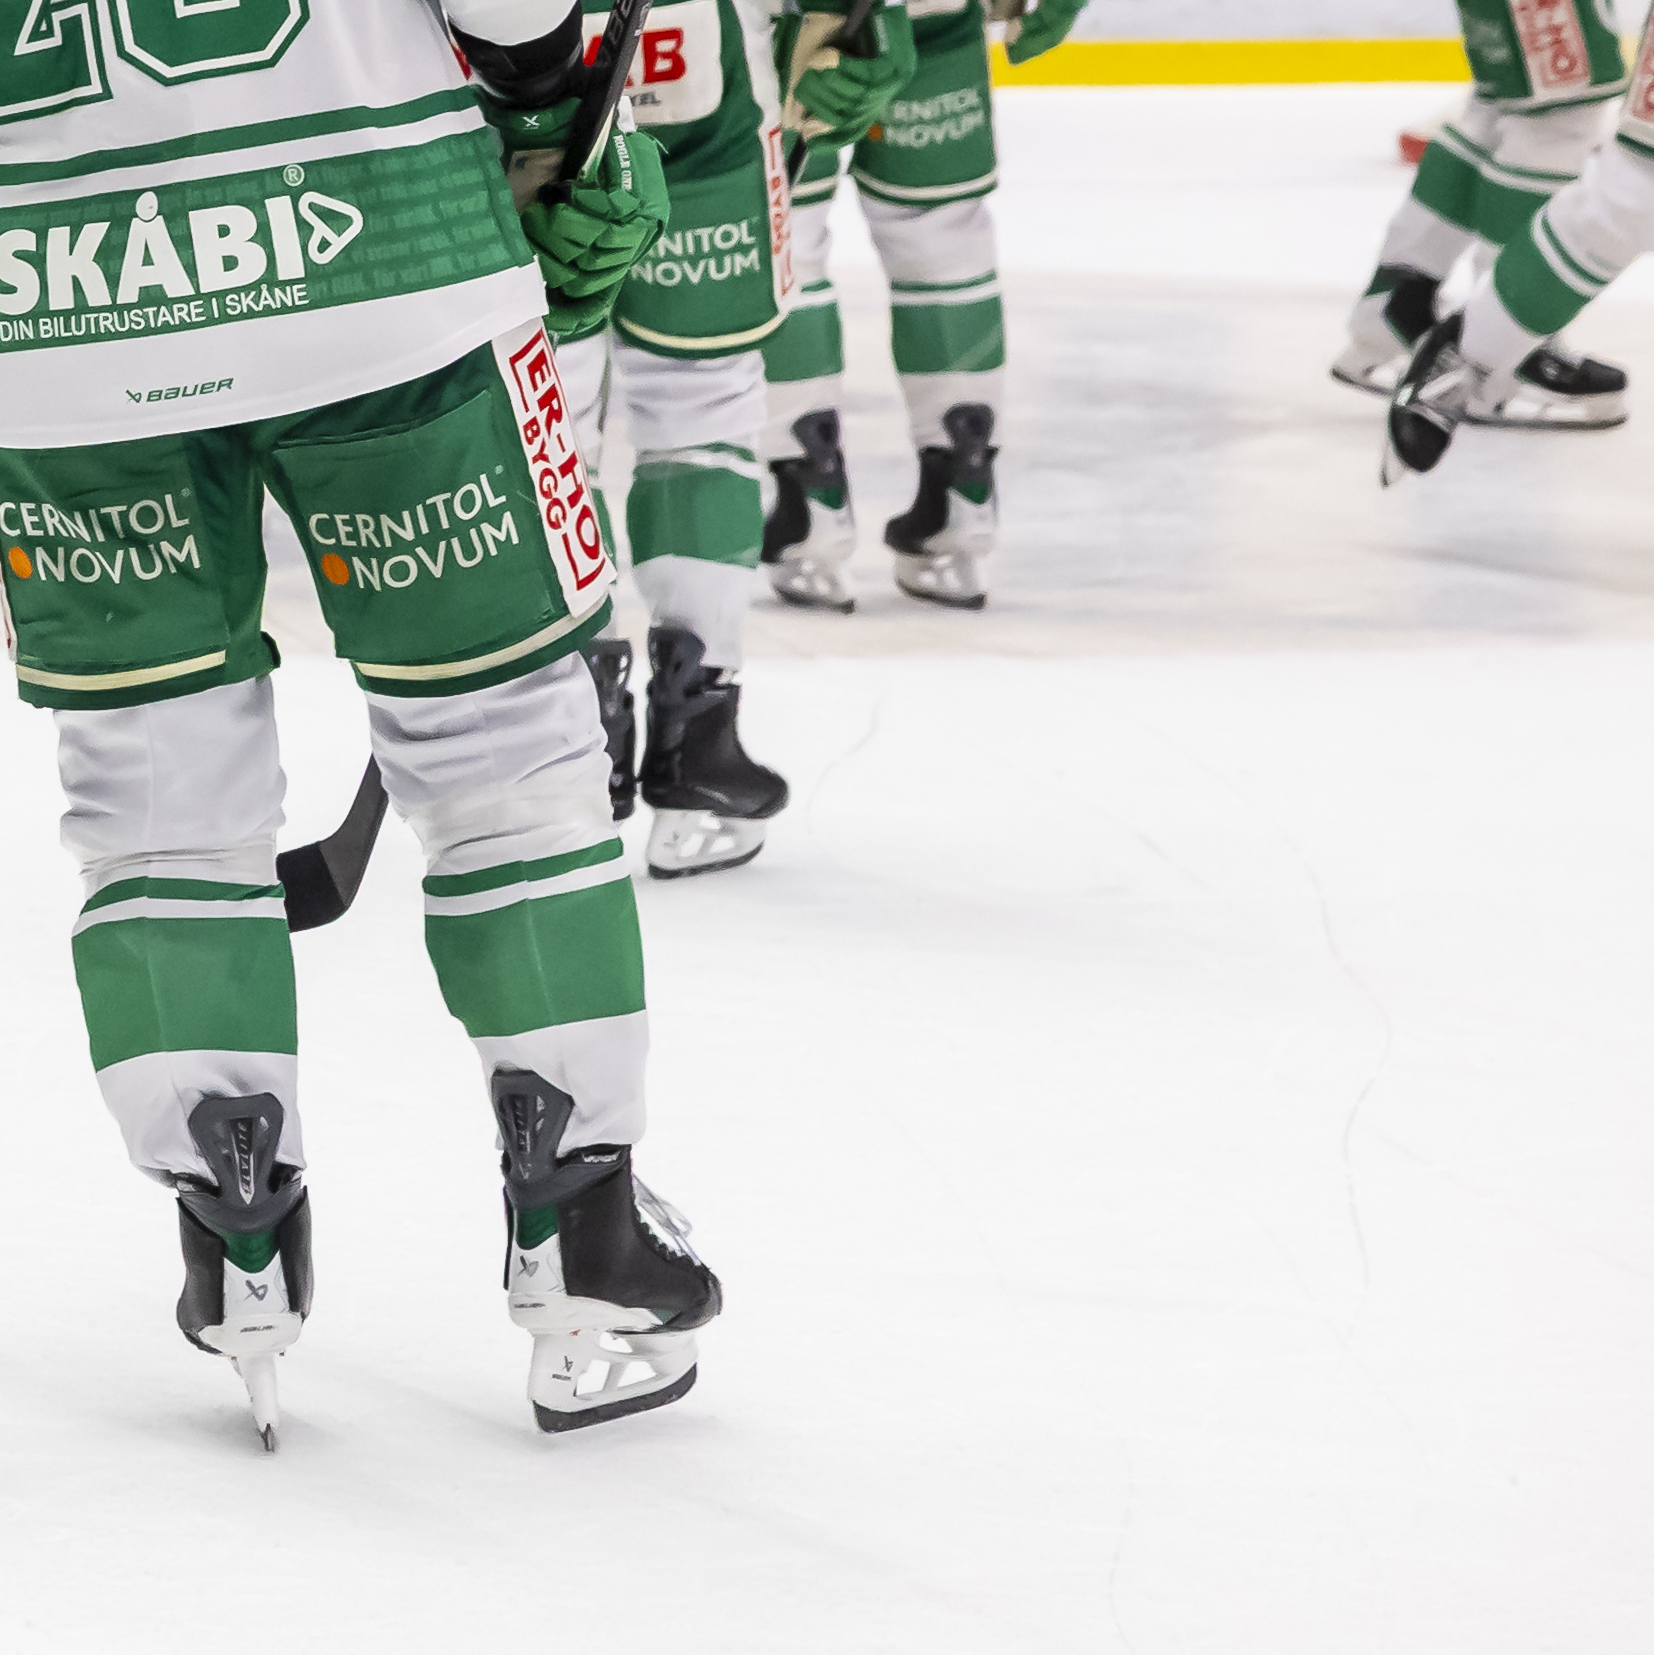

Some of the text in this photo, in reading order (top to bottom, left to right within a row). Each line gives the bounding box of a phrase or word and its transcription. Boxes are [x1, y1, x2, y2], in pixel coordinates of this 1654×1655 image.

[631, 247, 760, 286] NOVUM
[0, 283, 310, 343] DIN BILUTRUSTARE I SKÅNE
[146, 377, 235, 403] BAUER
[523, 416, 567, 531] BYGG
[527, 347, 601, 561] ER-HO
[309, 473, 507, 549] CERNITOL
[36, 534, 200, 585] NOVUM
[352, 511, 519, 592] NOVUM
